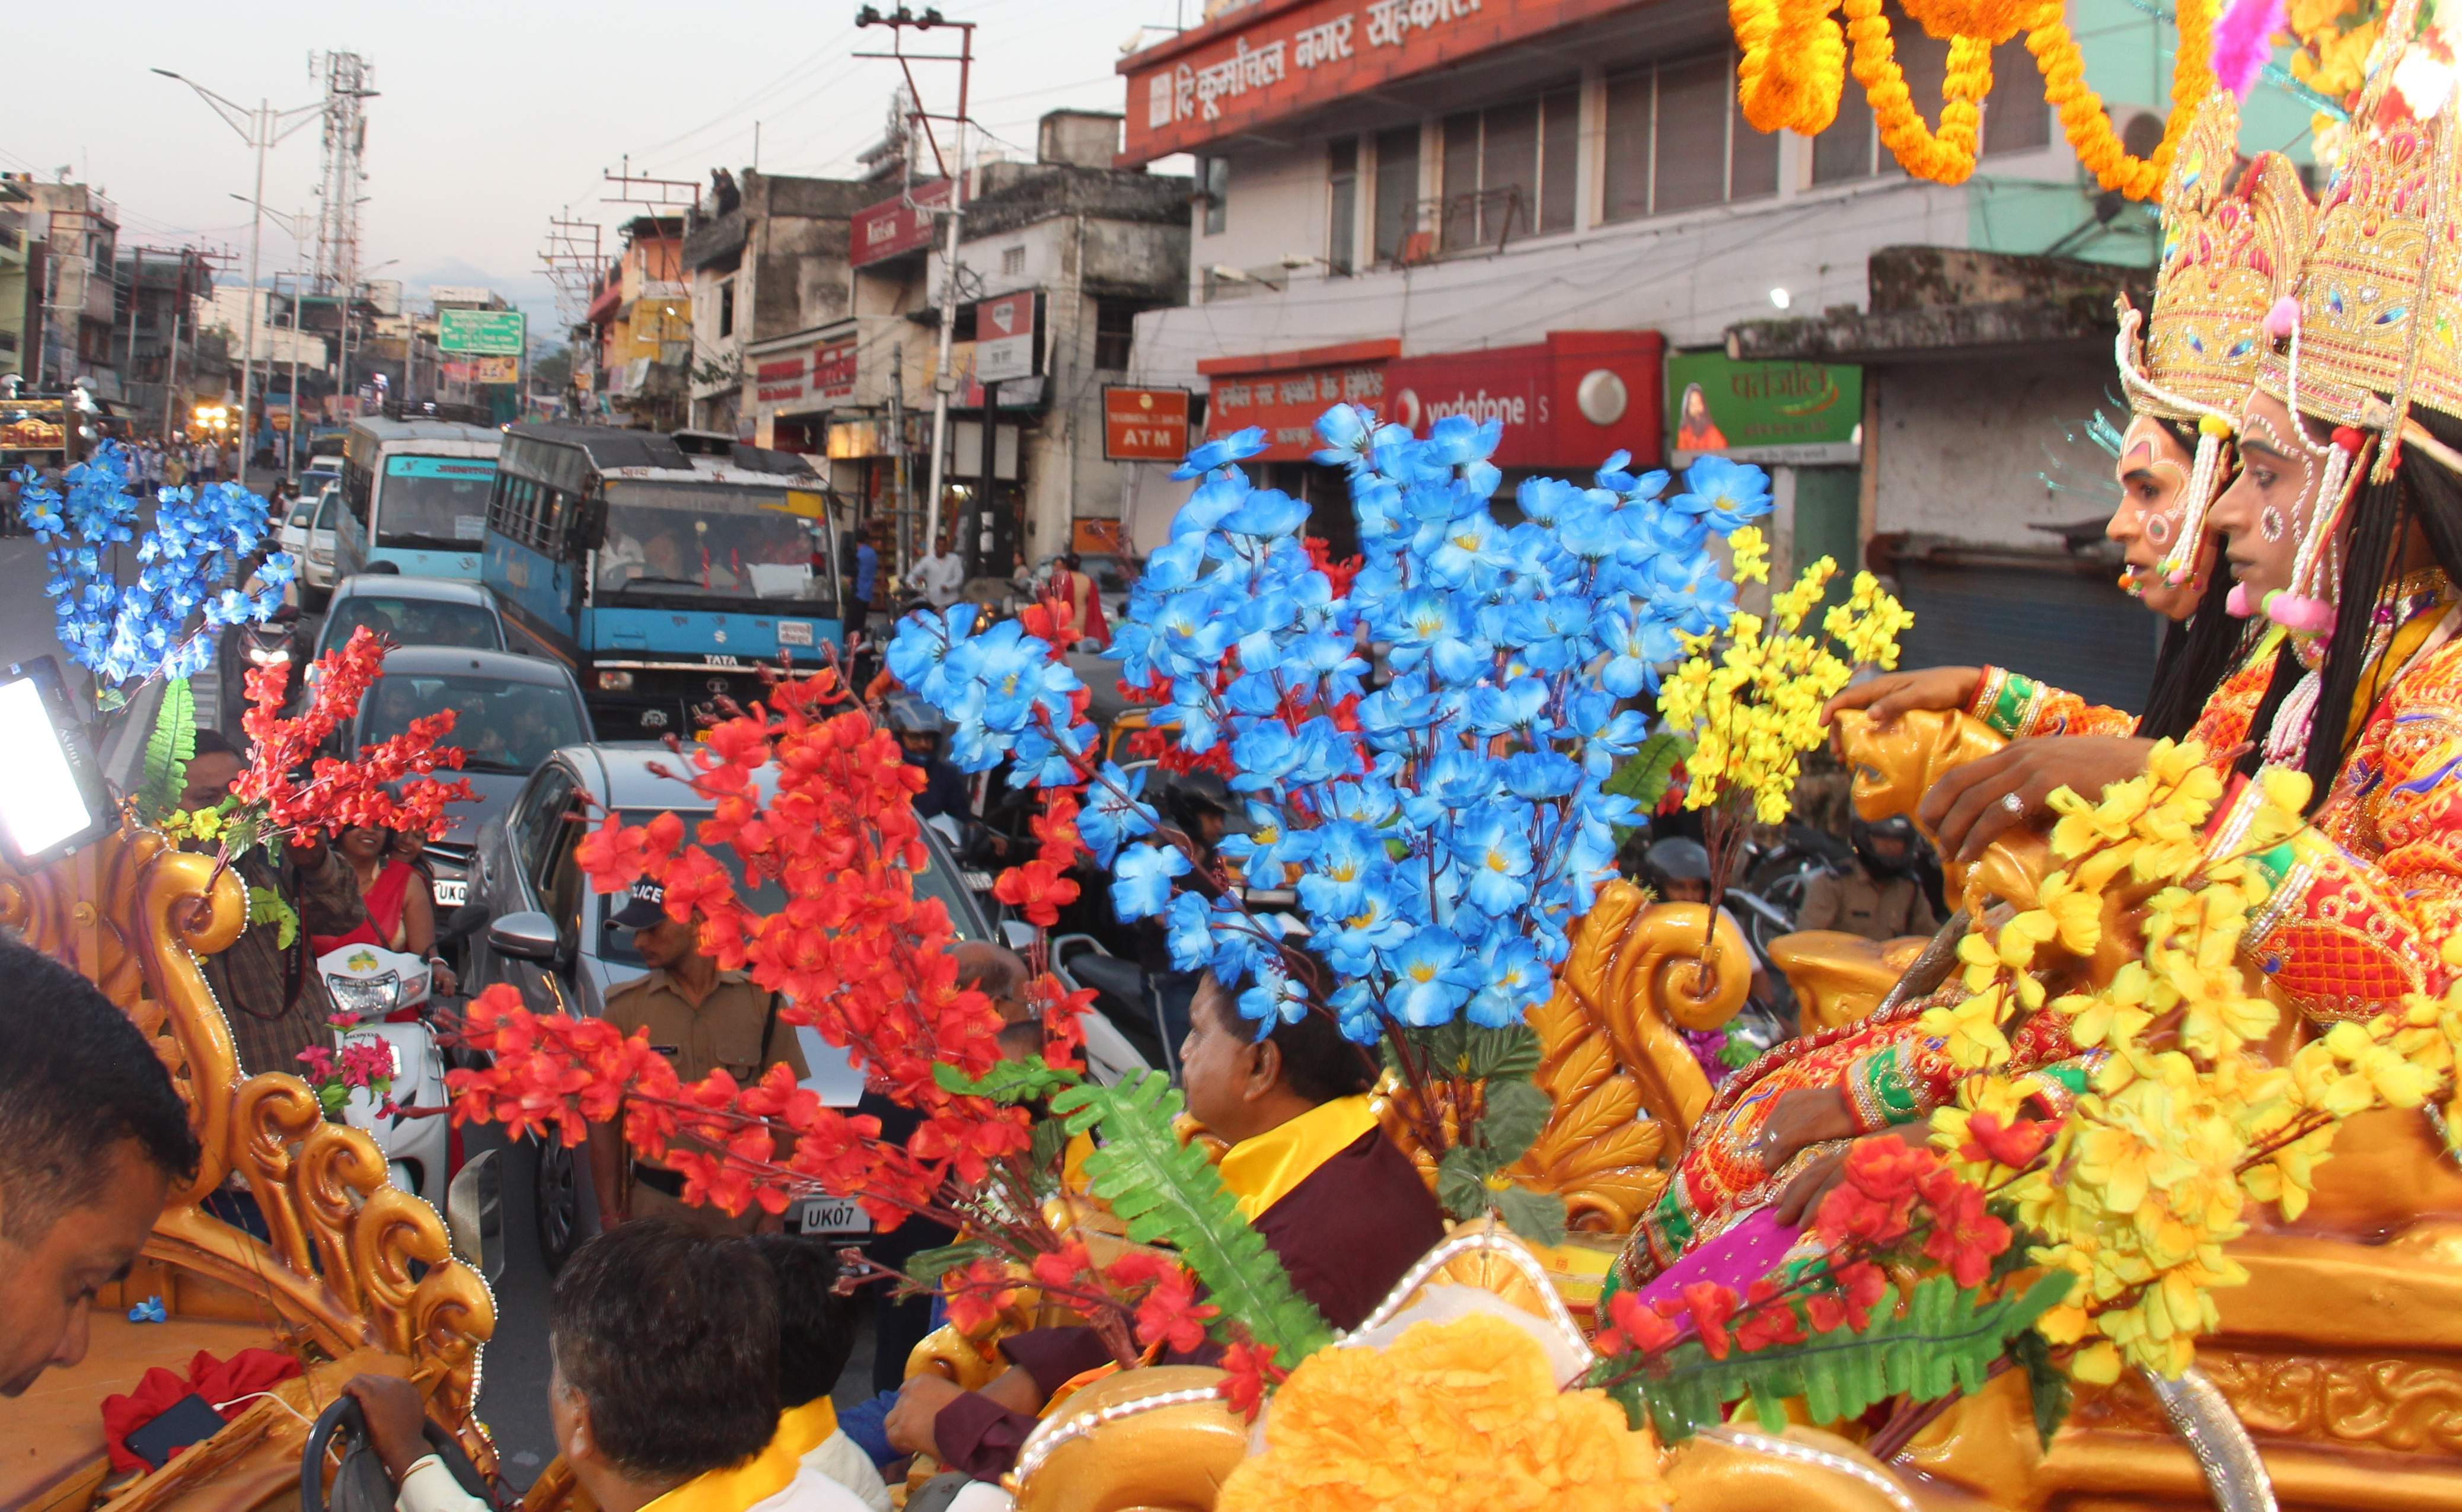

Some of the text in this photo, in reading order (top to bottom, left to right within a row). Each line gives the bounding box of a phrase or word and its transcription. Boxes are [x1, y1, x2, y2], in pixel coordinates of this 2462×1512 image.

[1176, 63, 1194, 120] दि
[1295, 13, 1356, 69] नगर
[1425, 389, 1527, 426] vodafone
[1123, 429, 1171, 448] ATM
[704, 654, 738, 666] TATA
[808, 1207, 854, 1228] UK07
